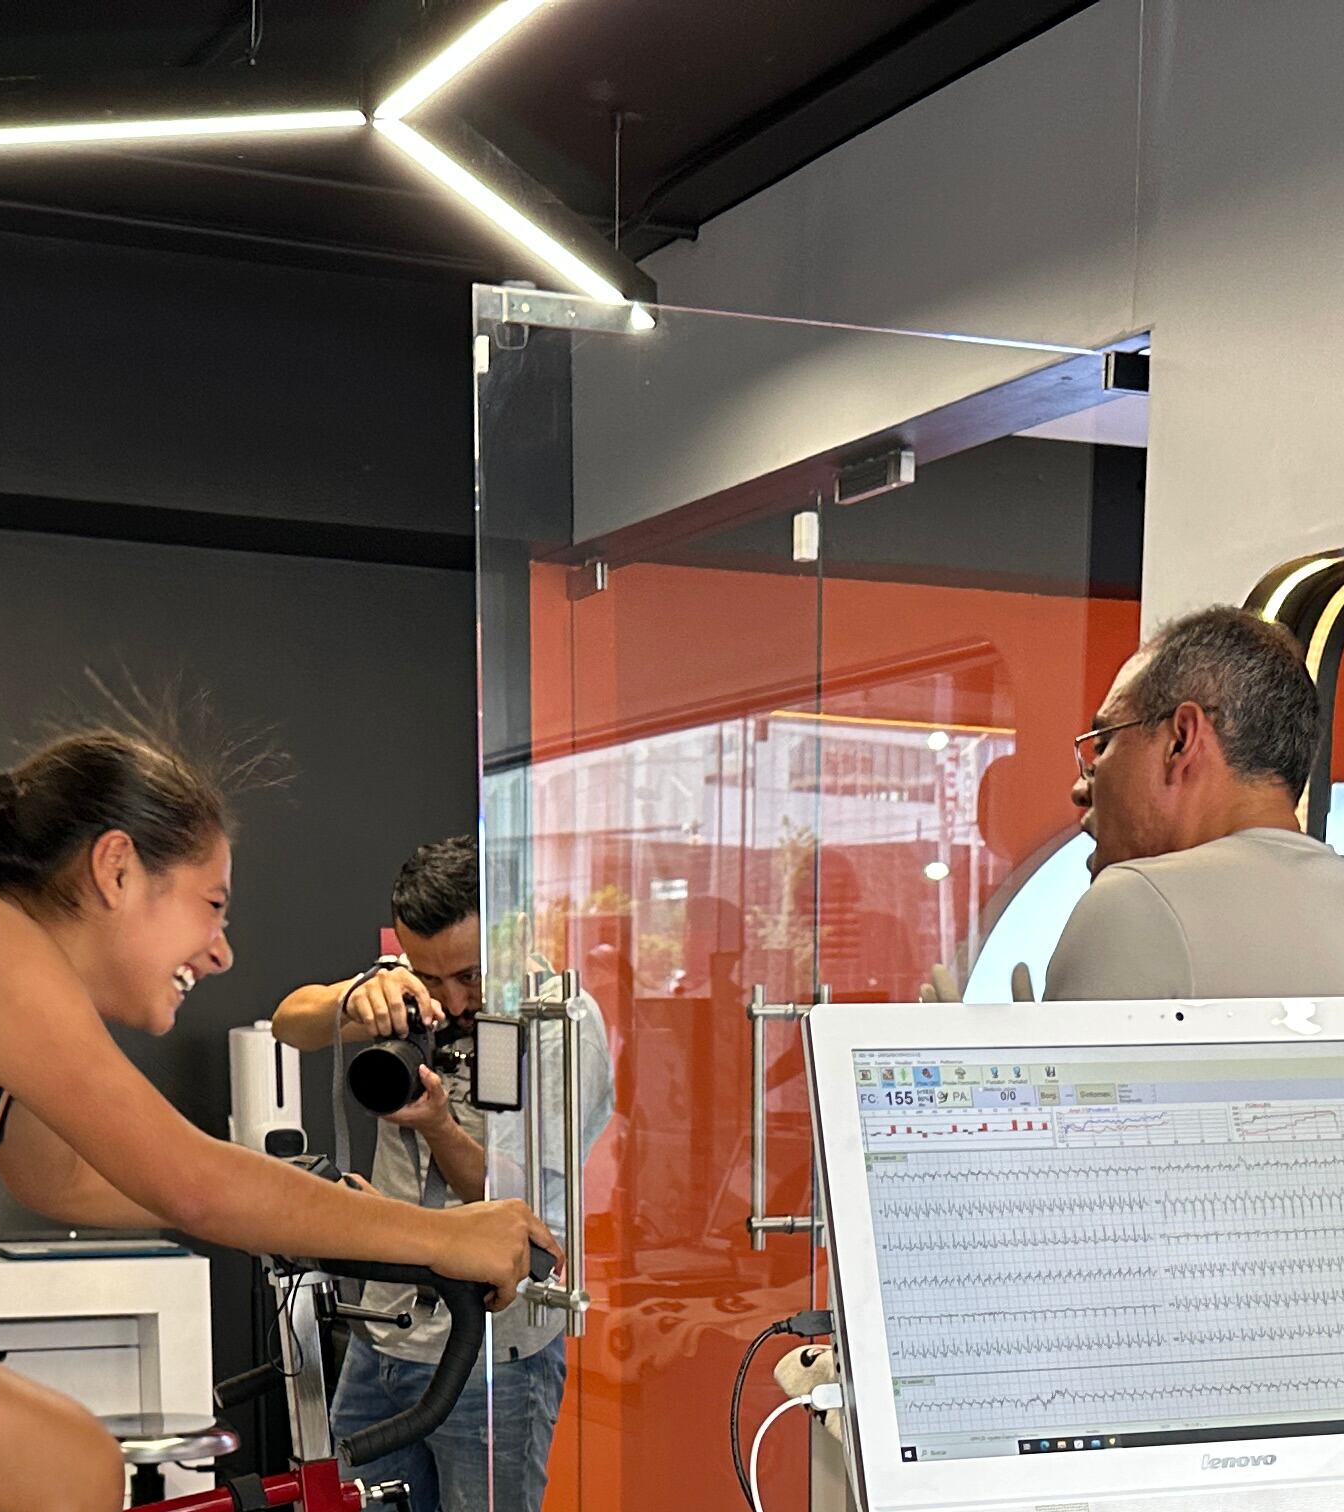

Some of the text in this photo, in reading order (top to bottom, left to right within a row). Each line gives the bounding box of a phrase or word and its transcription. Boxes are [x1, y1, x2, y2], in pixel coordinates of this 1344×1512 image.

[884, 1091, 914, 1106] 155
[953, 1092, 968, 1102] PA
[1000, 1091, 1017, 1101] 0/0
[1201, 1454, 1277, 1470] lenovo
